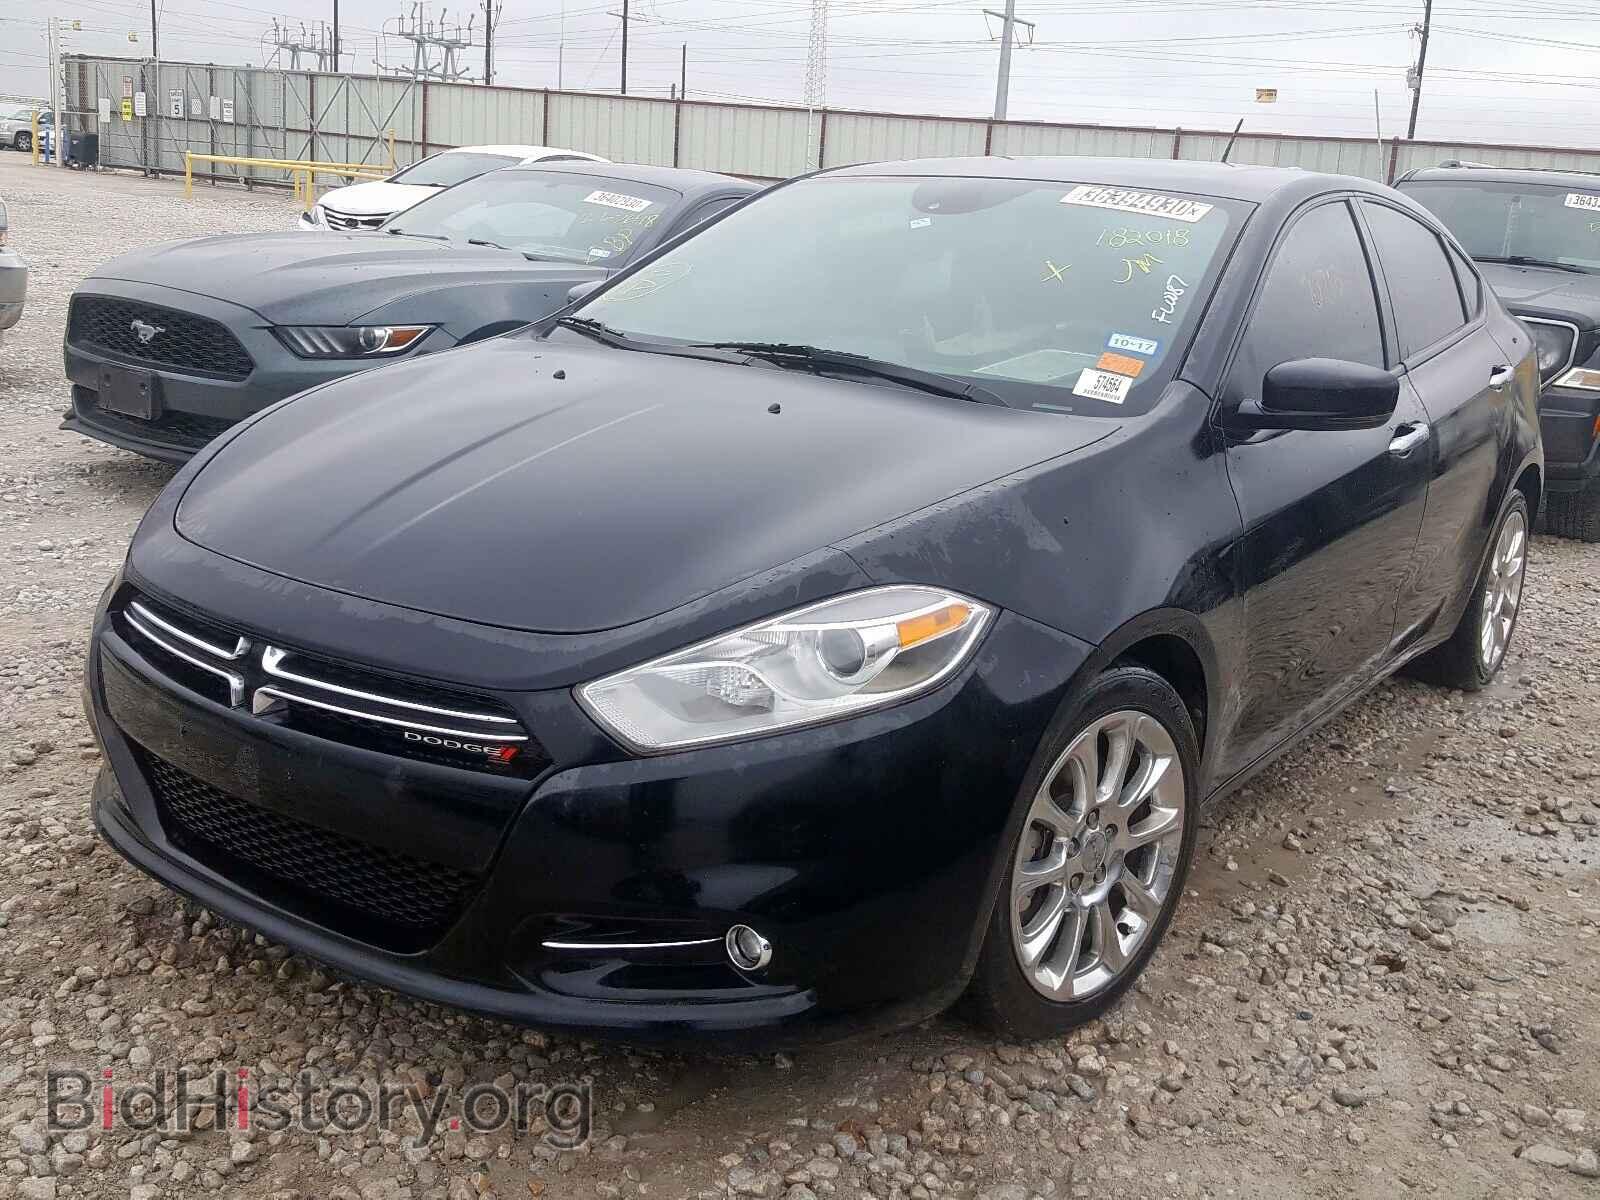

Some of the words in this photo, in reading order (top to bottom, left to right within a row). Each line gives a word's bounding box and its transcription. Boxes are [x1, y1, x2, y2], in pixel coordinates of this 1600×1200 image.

[174, 104, 180, 115] 5
[1573, 194, 1600, 208] 3643
[1113, 337, 1154, 352] 10-17
[403, 731, 502, 757] DODGE
